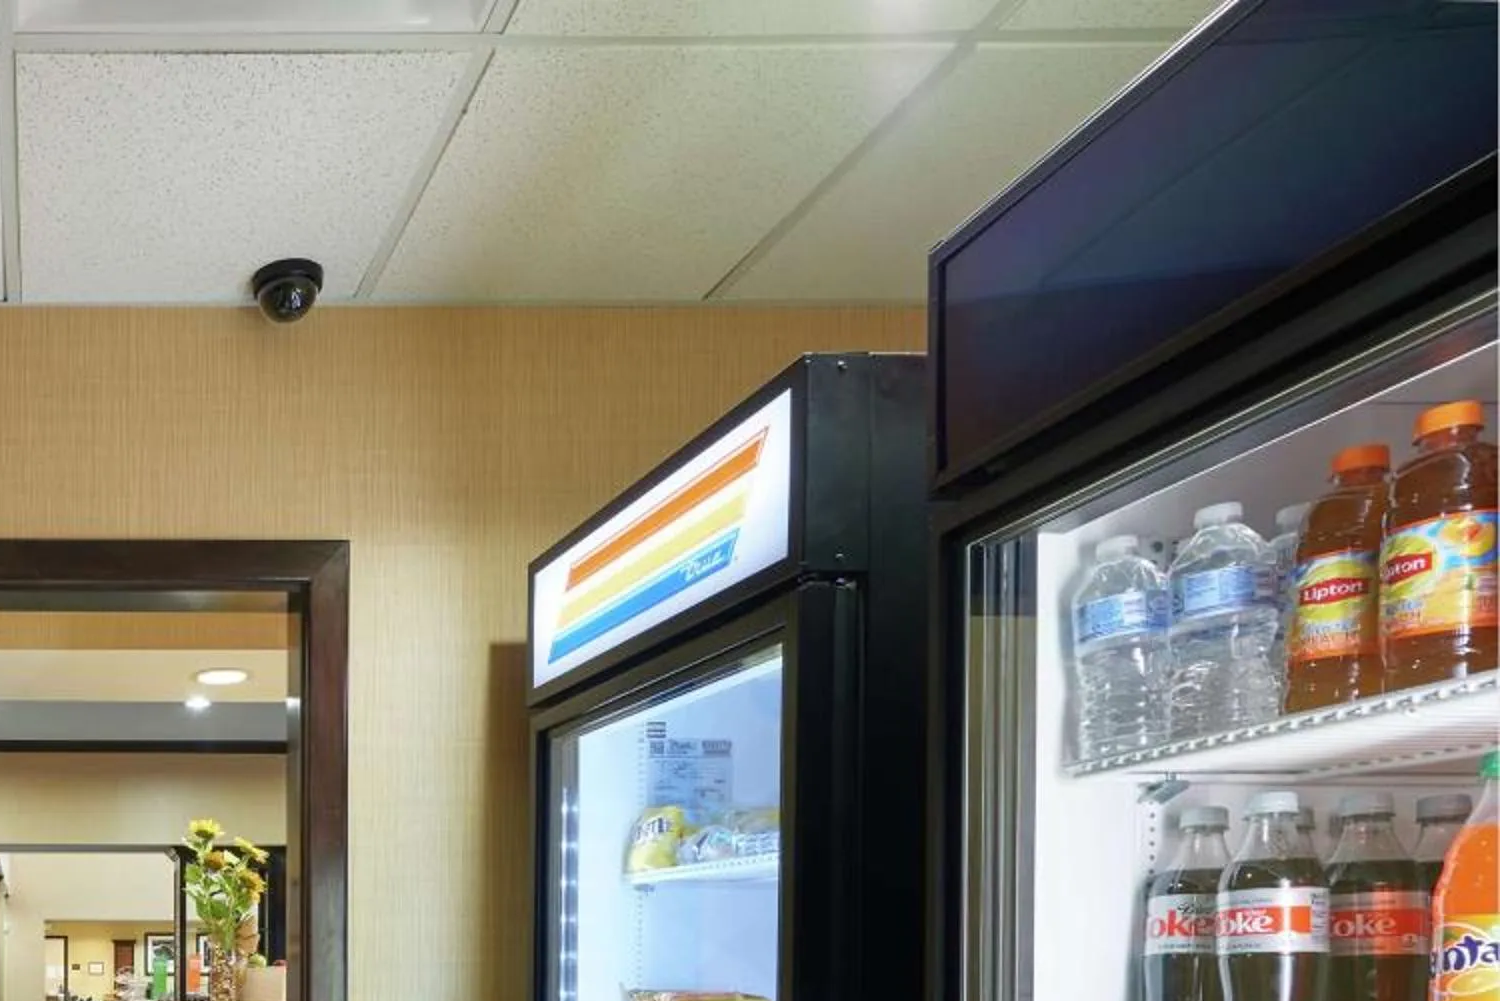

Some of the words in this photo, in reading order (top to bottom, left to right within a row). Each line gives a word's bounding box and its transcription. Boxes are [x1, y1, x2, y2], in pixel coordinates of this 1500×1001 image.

[1303, 582, 1362, 600] Lipton
[1334, 910, 1397, 937] oke
[1443, 934, 1499, 971] nta
